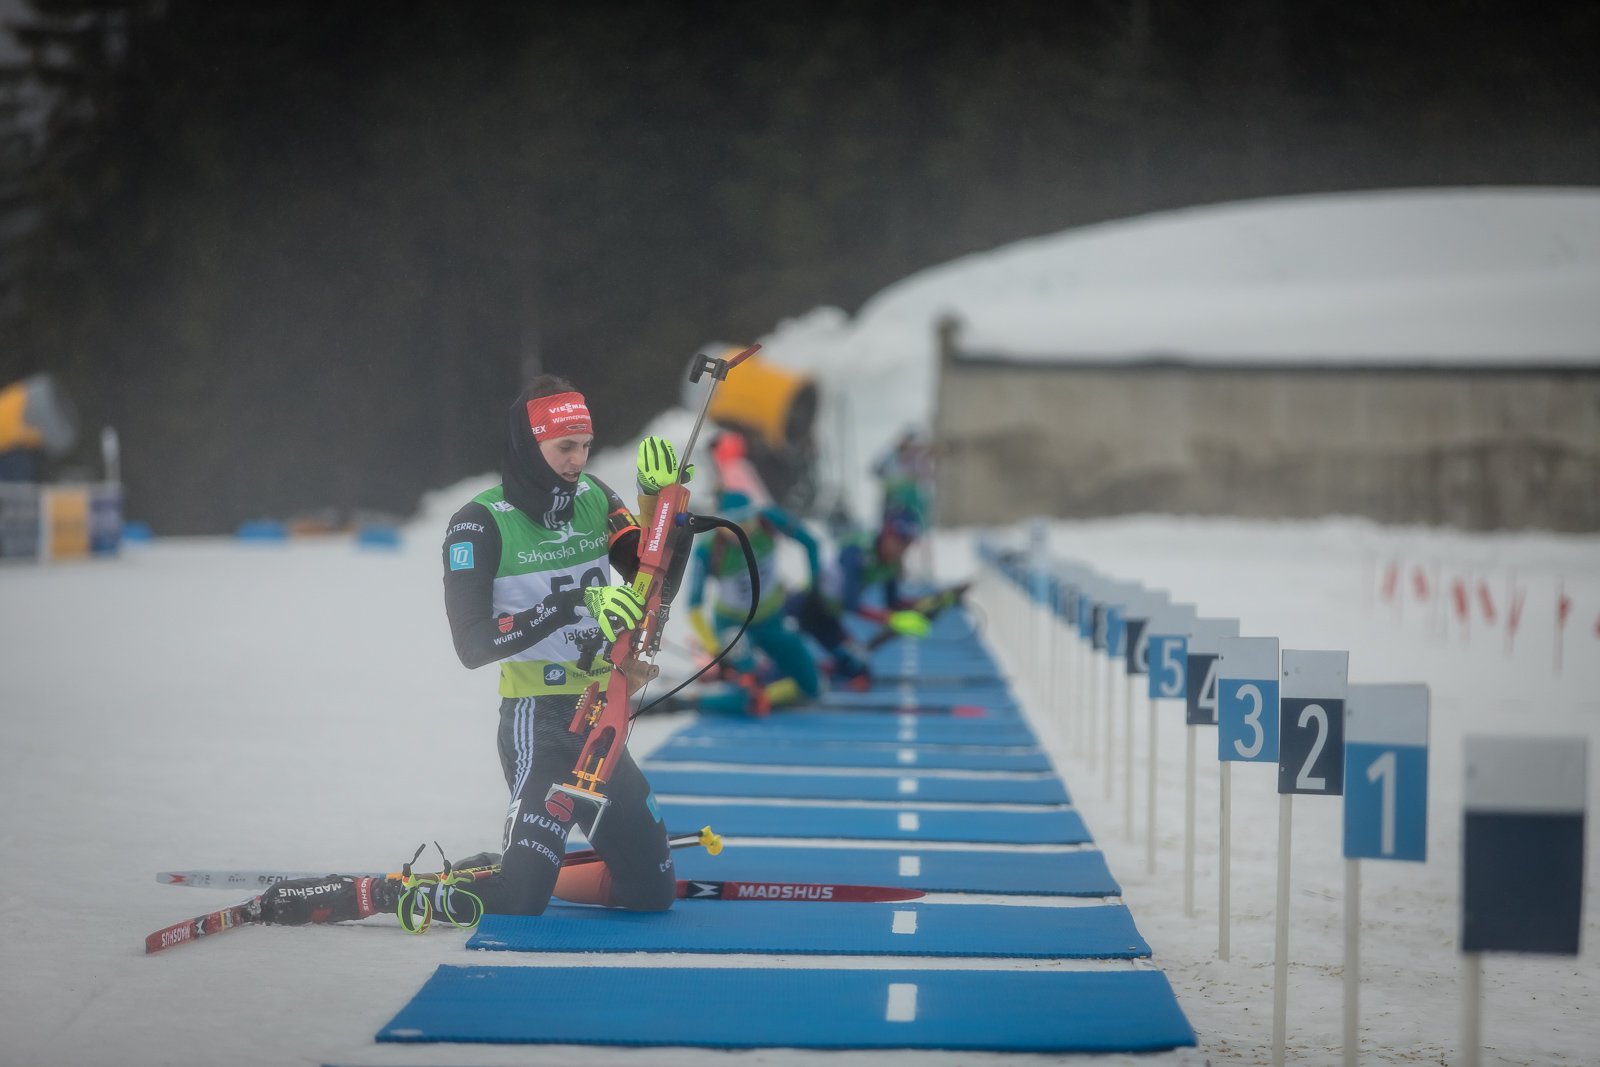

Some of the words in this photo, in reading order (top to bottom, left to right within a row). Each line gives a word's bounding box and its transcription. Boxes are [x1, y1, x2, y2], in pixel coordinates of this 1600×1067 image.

[453, 522, 485, 533] TERREX
[452, 546, 470, 566] TQ
[517, 545, 576, 564] Szklarska
[579, 531, 609, 552] Poręb
[563, 627, 601, 645] Jakusz
[1159, 638, 1186, 697] 5
[1197, 656, 1219, 723] 4
[1233, 683, 1265, 759] 3
[1295, 703, 1329, 790] 2
[1366, 751, 1397, 856] 1
[522, 813, 568, 842] WÜRT
[531, 840, 561, 867] TERREX
[279, 882, 342, 898] MADSHUS
[738, 885, 834, 899] MADSHUS
[161, 925, 192, 947] MADSHUS
